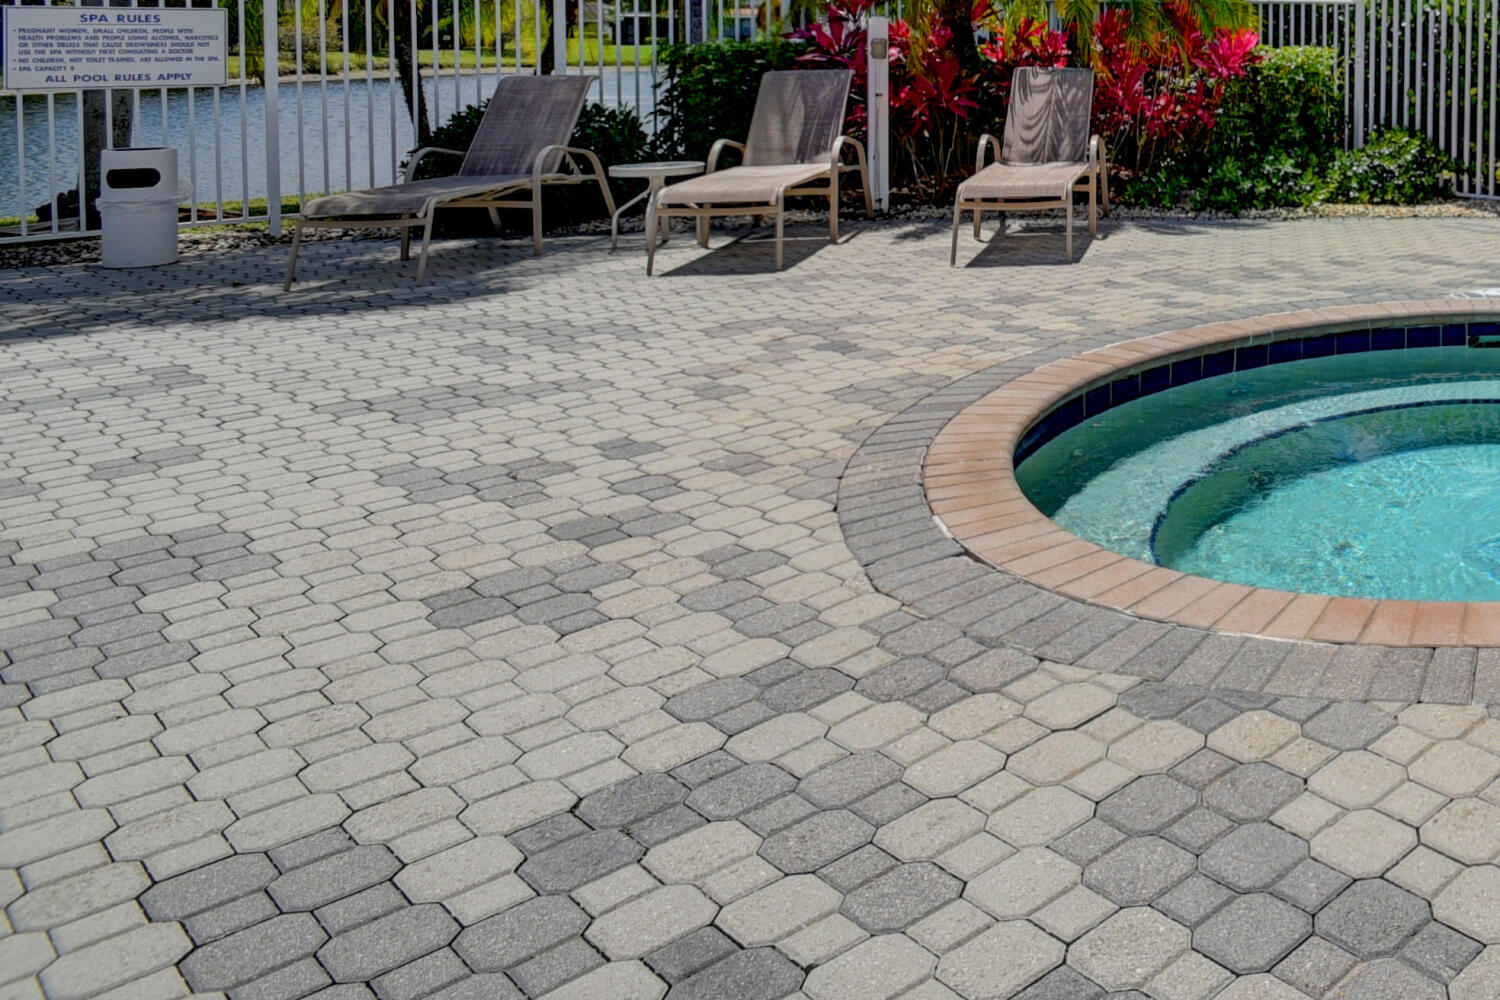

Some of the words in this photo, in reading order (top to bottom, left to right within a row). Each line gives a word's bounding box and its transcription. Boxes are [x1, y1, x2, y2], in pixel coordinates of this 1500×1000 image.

[80, 14, 109, 23] SPA
[116, 14, 161, 23] RULES
[45, 75, 68, 83] ALL
[73, 74, 109, 82] POOL
